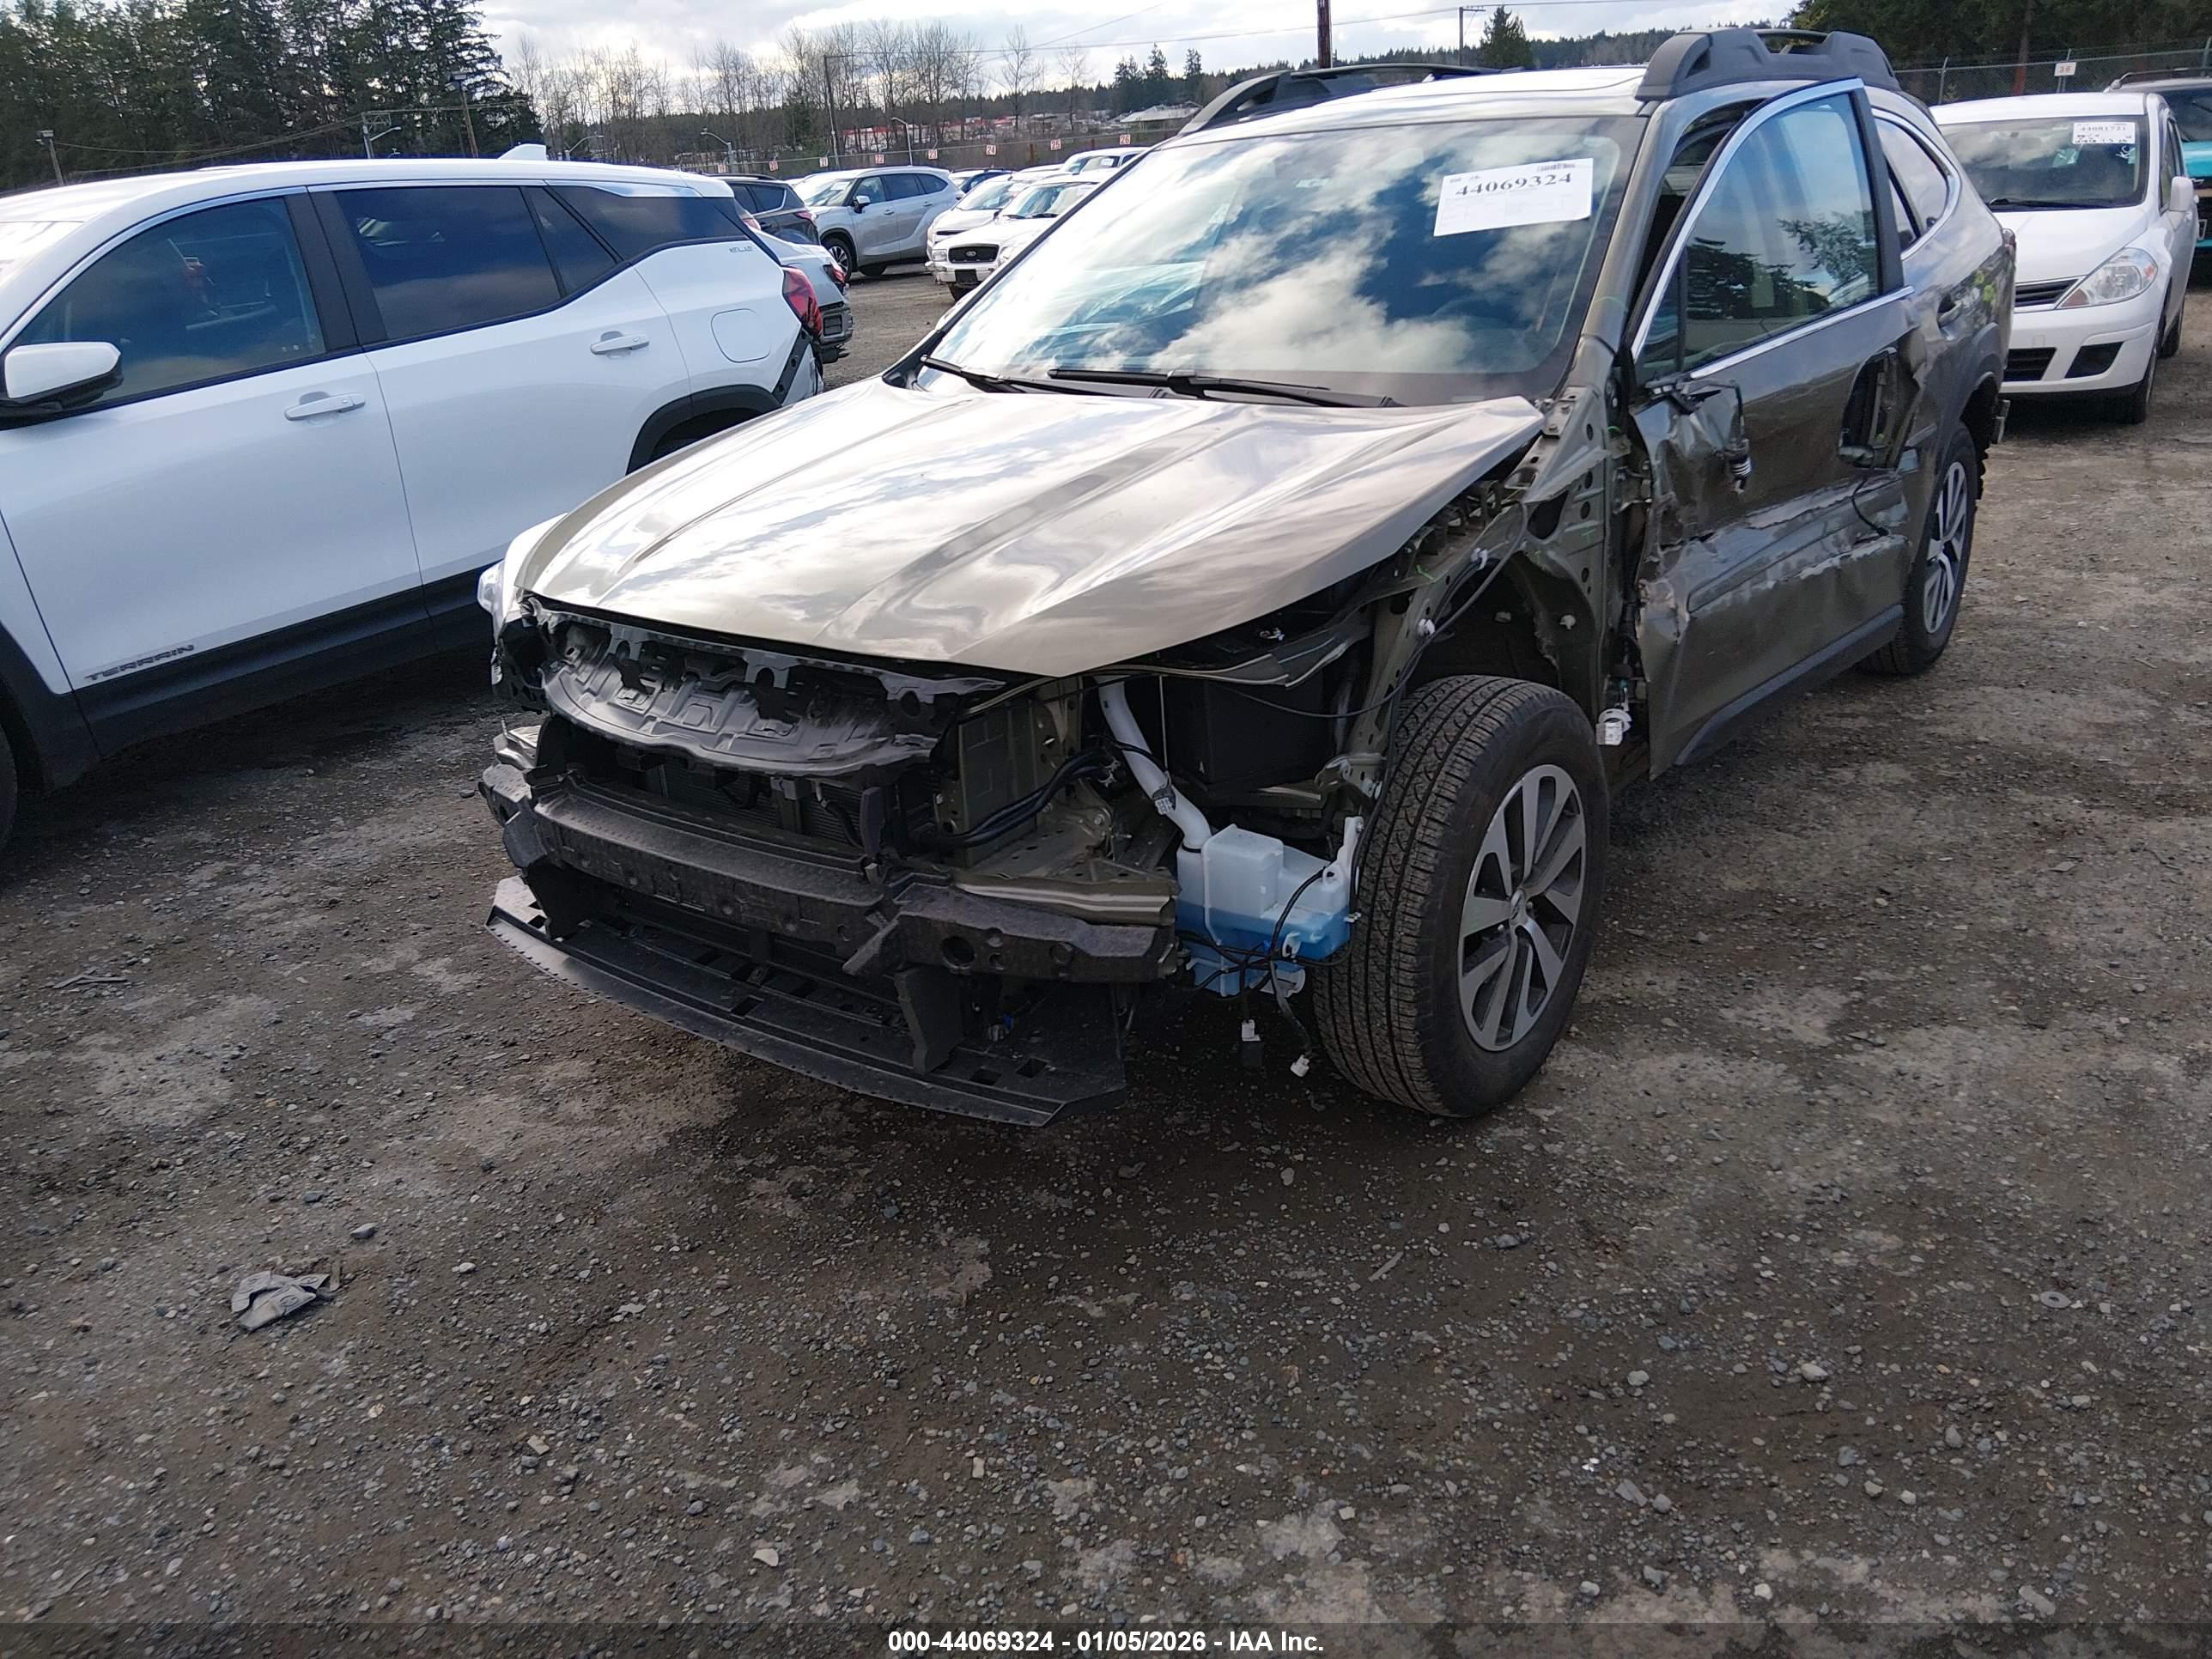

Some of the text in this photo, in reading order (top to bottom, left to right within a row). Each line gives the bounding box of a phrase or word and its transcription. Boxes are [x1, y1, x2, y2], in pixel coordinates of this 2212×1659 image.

[1051, 140, 1060, 149] 25
[1121, 135, 1130, 144] 26
[1455, 173, 1571, 196] 44069324
[84, 644, 194, 680] TERRAIN
